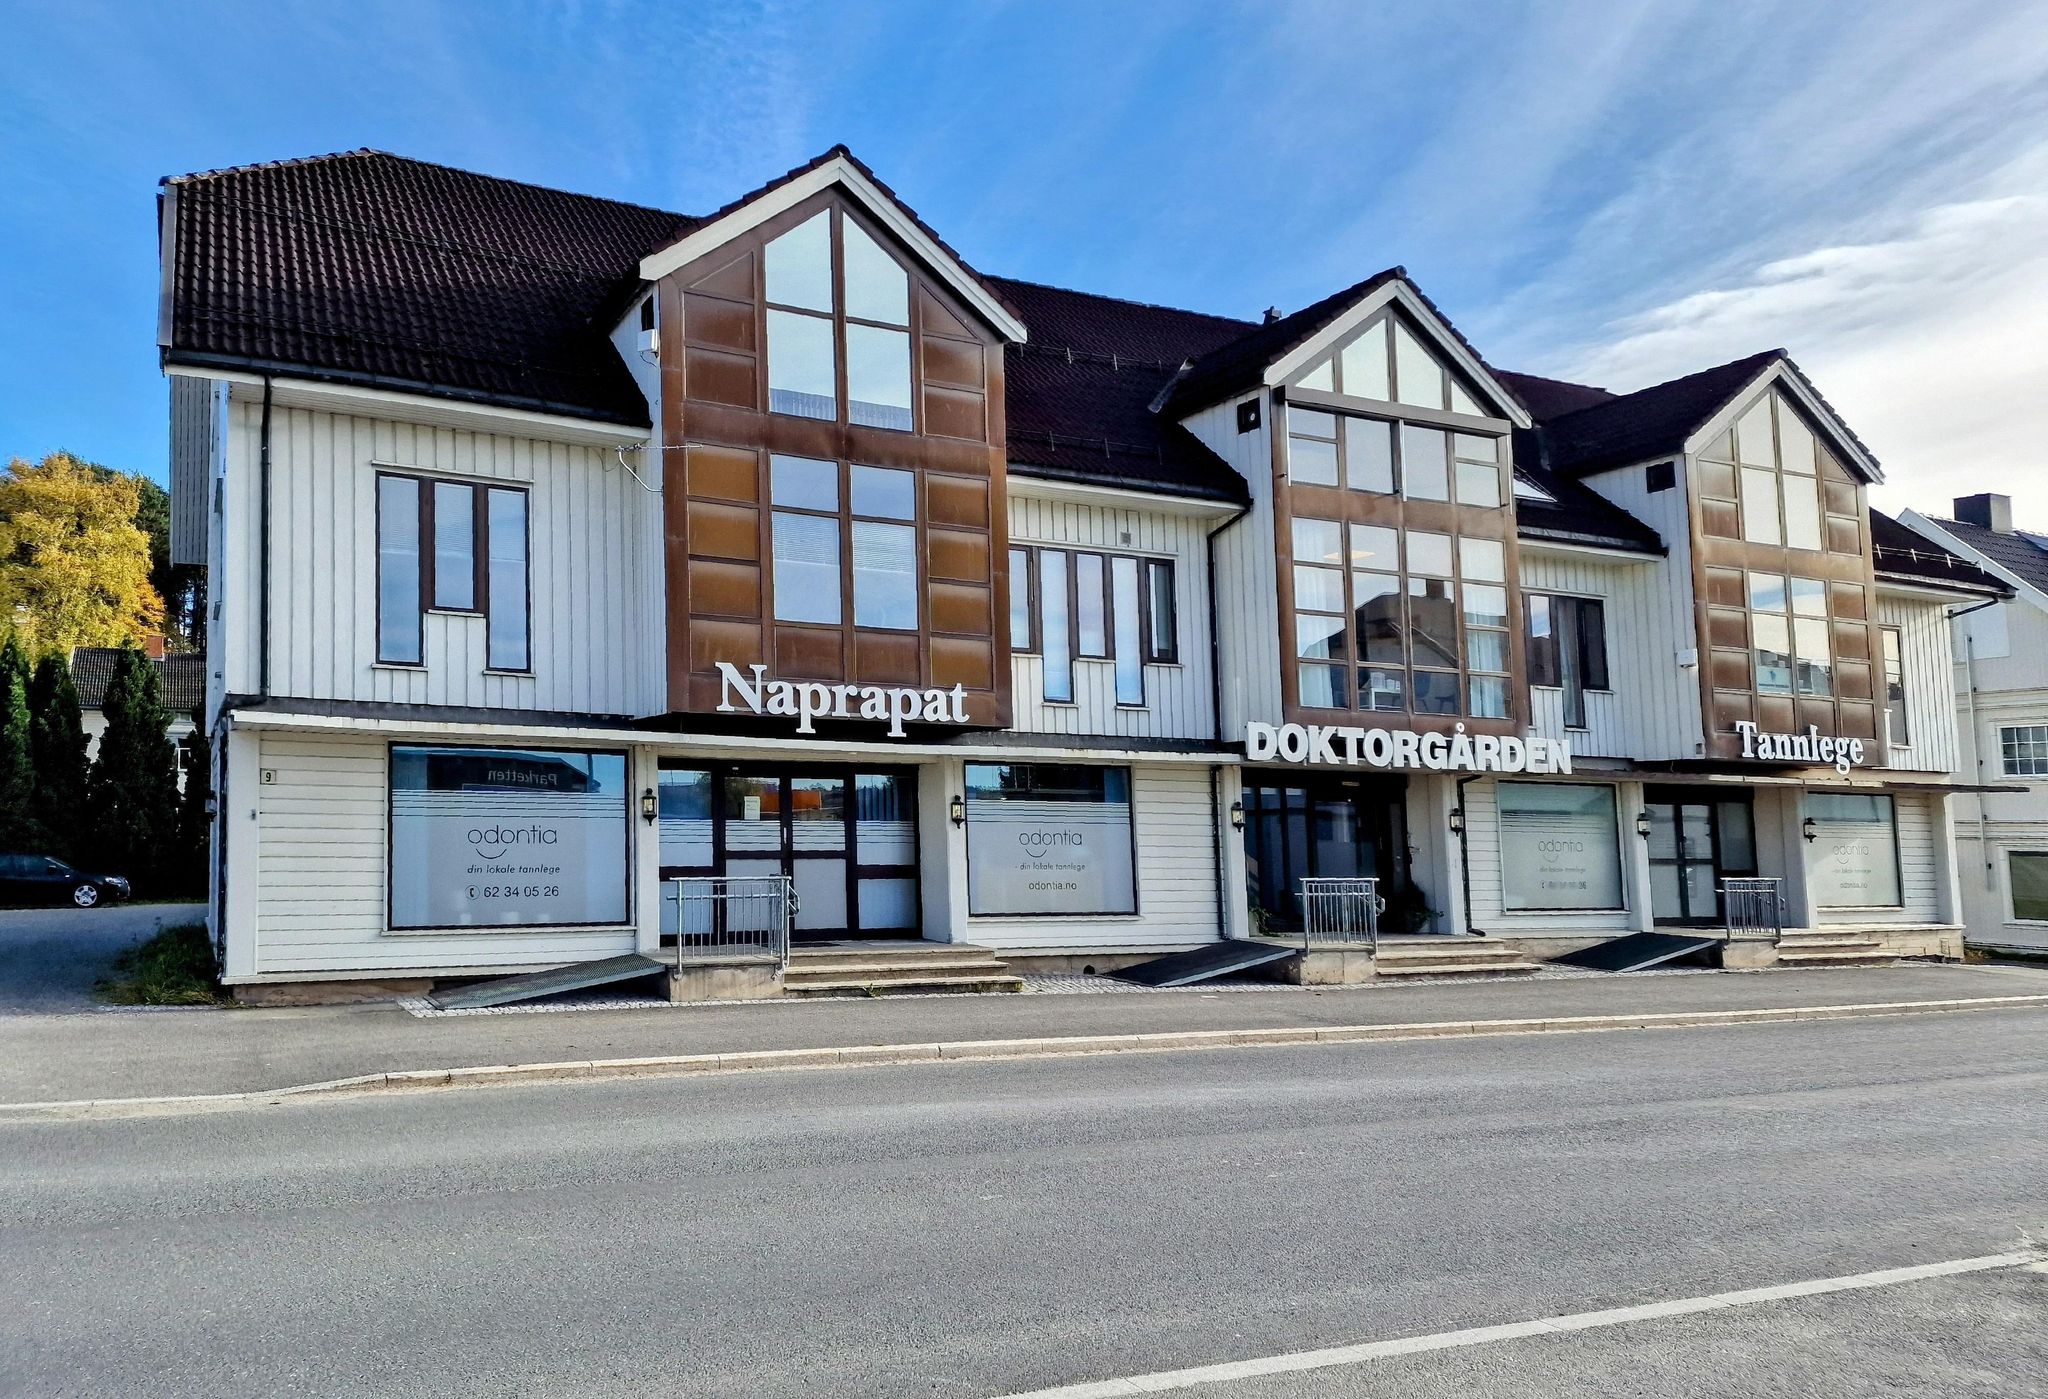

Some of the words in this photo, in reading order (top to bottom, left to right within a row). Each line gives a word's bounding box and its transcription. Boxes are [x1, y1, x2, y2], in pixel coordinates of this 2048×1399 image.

[715, 661, 970, 737] Naprapat
[1247, 721, 1573, 775] DOKTORGÅRDEN
[1735, 720, 1864, 775] Tannlege
[266, 771, 272, 782] 9
[467, 824, 558, 844] odontia
[1018, 828, 1083, 846] odontia
[467, 864, 483, 874] din
[486, 864, 516, 874] lokale
[518, 864, 561, 875] tannlege
[483, 886, 500, 898] 62
[503, 886, 520, 897] 34
[523, 886, 540, 897] 05
[543, 885, 560, 897] 26
[1028, 881, 1077, 890] odontia.no
